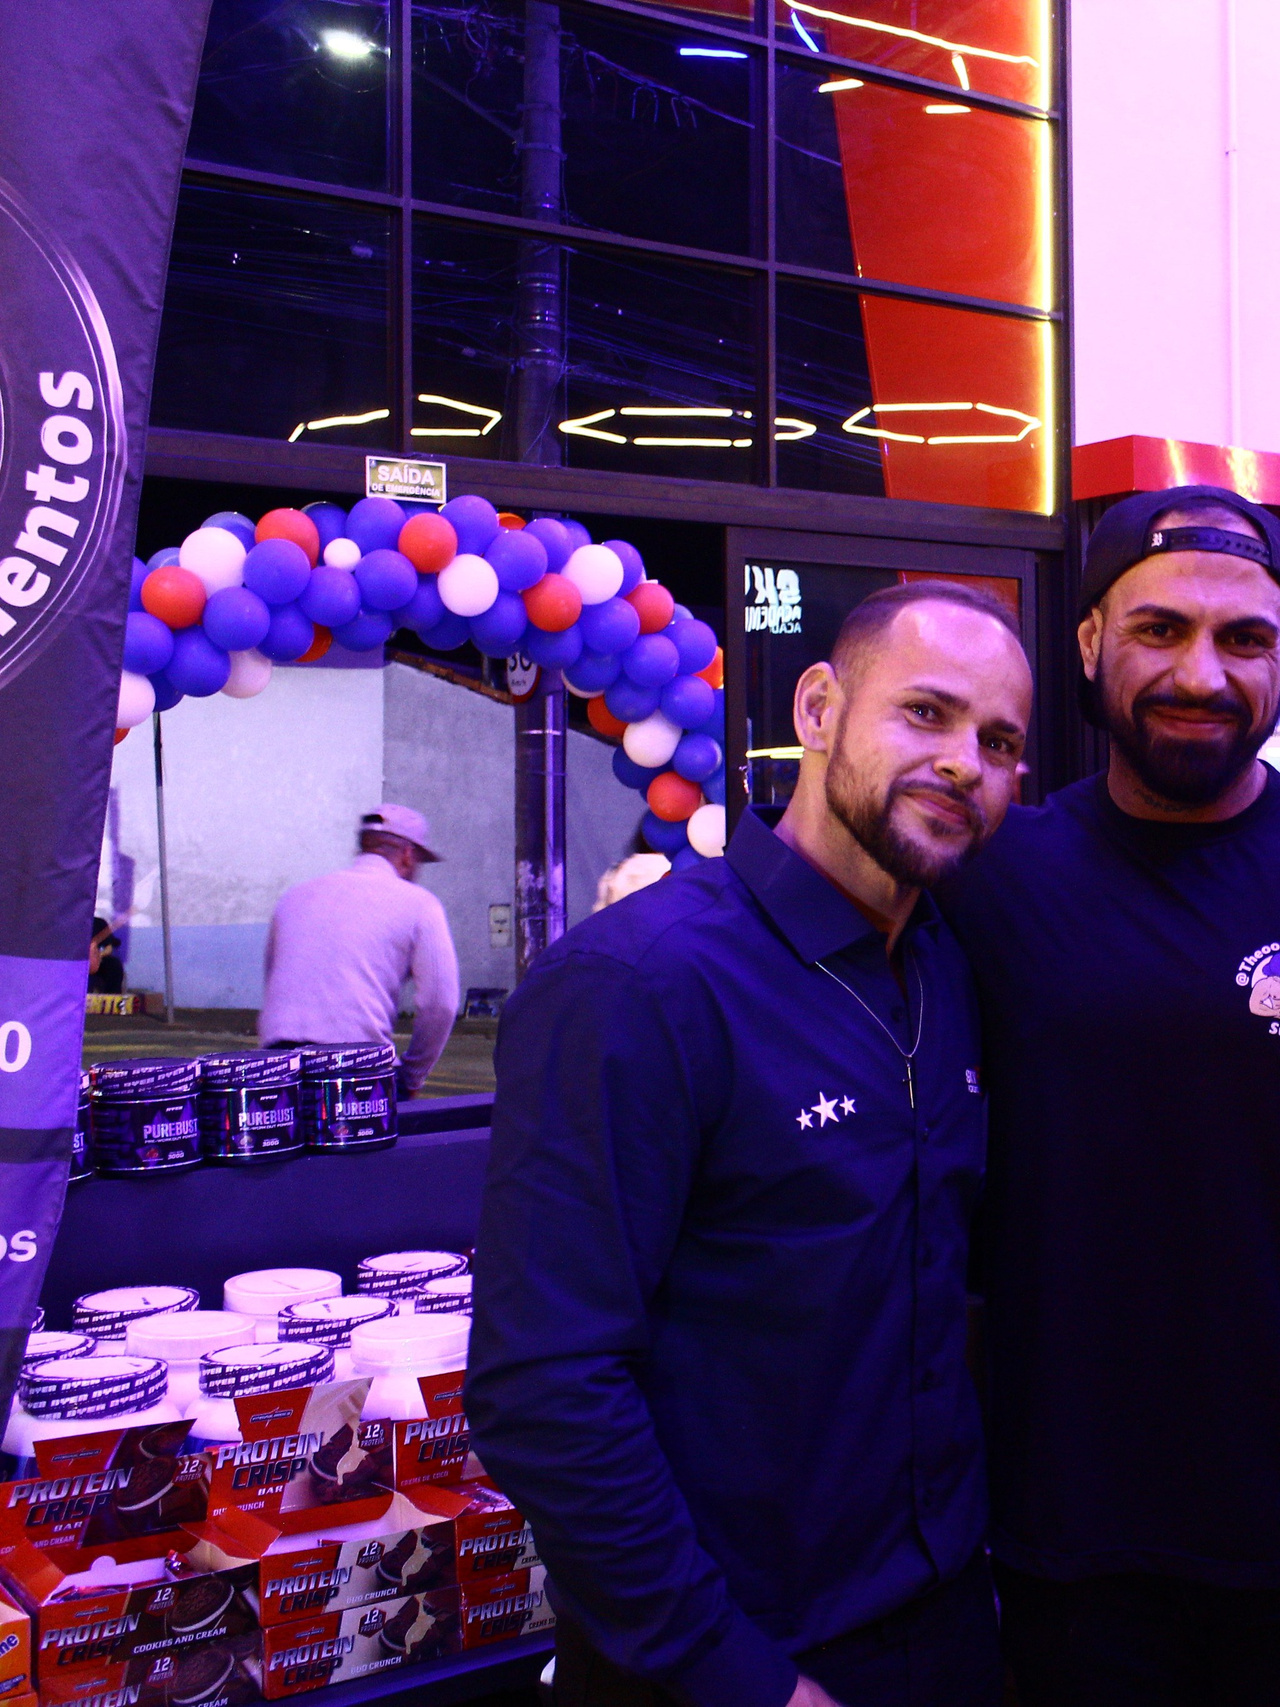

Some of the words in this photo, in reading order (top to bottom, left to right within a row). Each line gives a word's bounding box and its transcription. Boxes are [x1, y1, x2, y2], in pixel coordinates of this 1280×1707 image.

[378, 464, 435, 486] SAÍDA
[371, 483, 384, 491] DE
[385, 483, 440, 496] EMERGÊNCIA
[239, 1107, 294, 1127] PUREBUST
[335, 1098, 388, 1117] PUREBUST
[143, 1118, 198, 1139] PUREBUST
[216, 1431, 325, 1469] PROTEIN
[418, 1432, 471, 1462] CRIS
[8, 1467, 134, 1508] PROTEIN
[232, 1457, 309, 1490] CRISP
[257, 1485, 284, 1496] BAR
[25, 1492, 113, 1527] CRISP
[50, 1535, 75, 1546] CREAM
[53, 1521, 83, 1533] BAR
[460, 1528, 534, 1556] PROTEIN
[473, 1546, 526, 1571] CRISP
[265, 1566, 353, 1598] PROTEIN
[364, 1586, 398, 1600] CRUNCH
[279, 1586, 340, 1614] CRISP
[467, 1590, 544, 1624] PROTEIN
[40, 1611, 141, 1650] PROTEIN
[480, 1610, 534, 1637] CRISP
[57, 1635, 125, 1666] CRISP
[133, 1638, 173, 1654] COOKIES
[174, 1633, 194, 1645] AND
[195, 1626, 228, 1640] CREAM
[269, 1635, 355, 1671] PROTEIN
[284, 1656, 344, 1686] CRISP
[369, 1656, 402, 1670] CRUNCH
